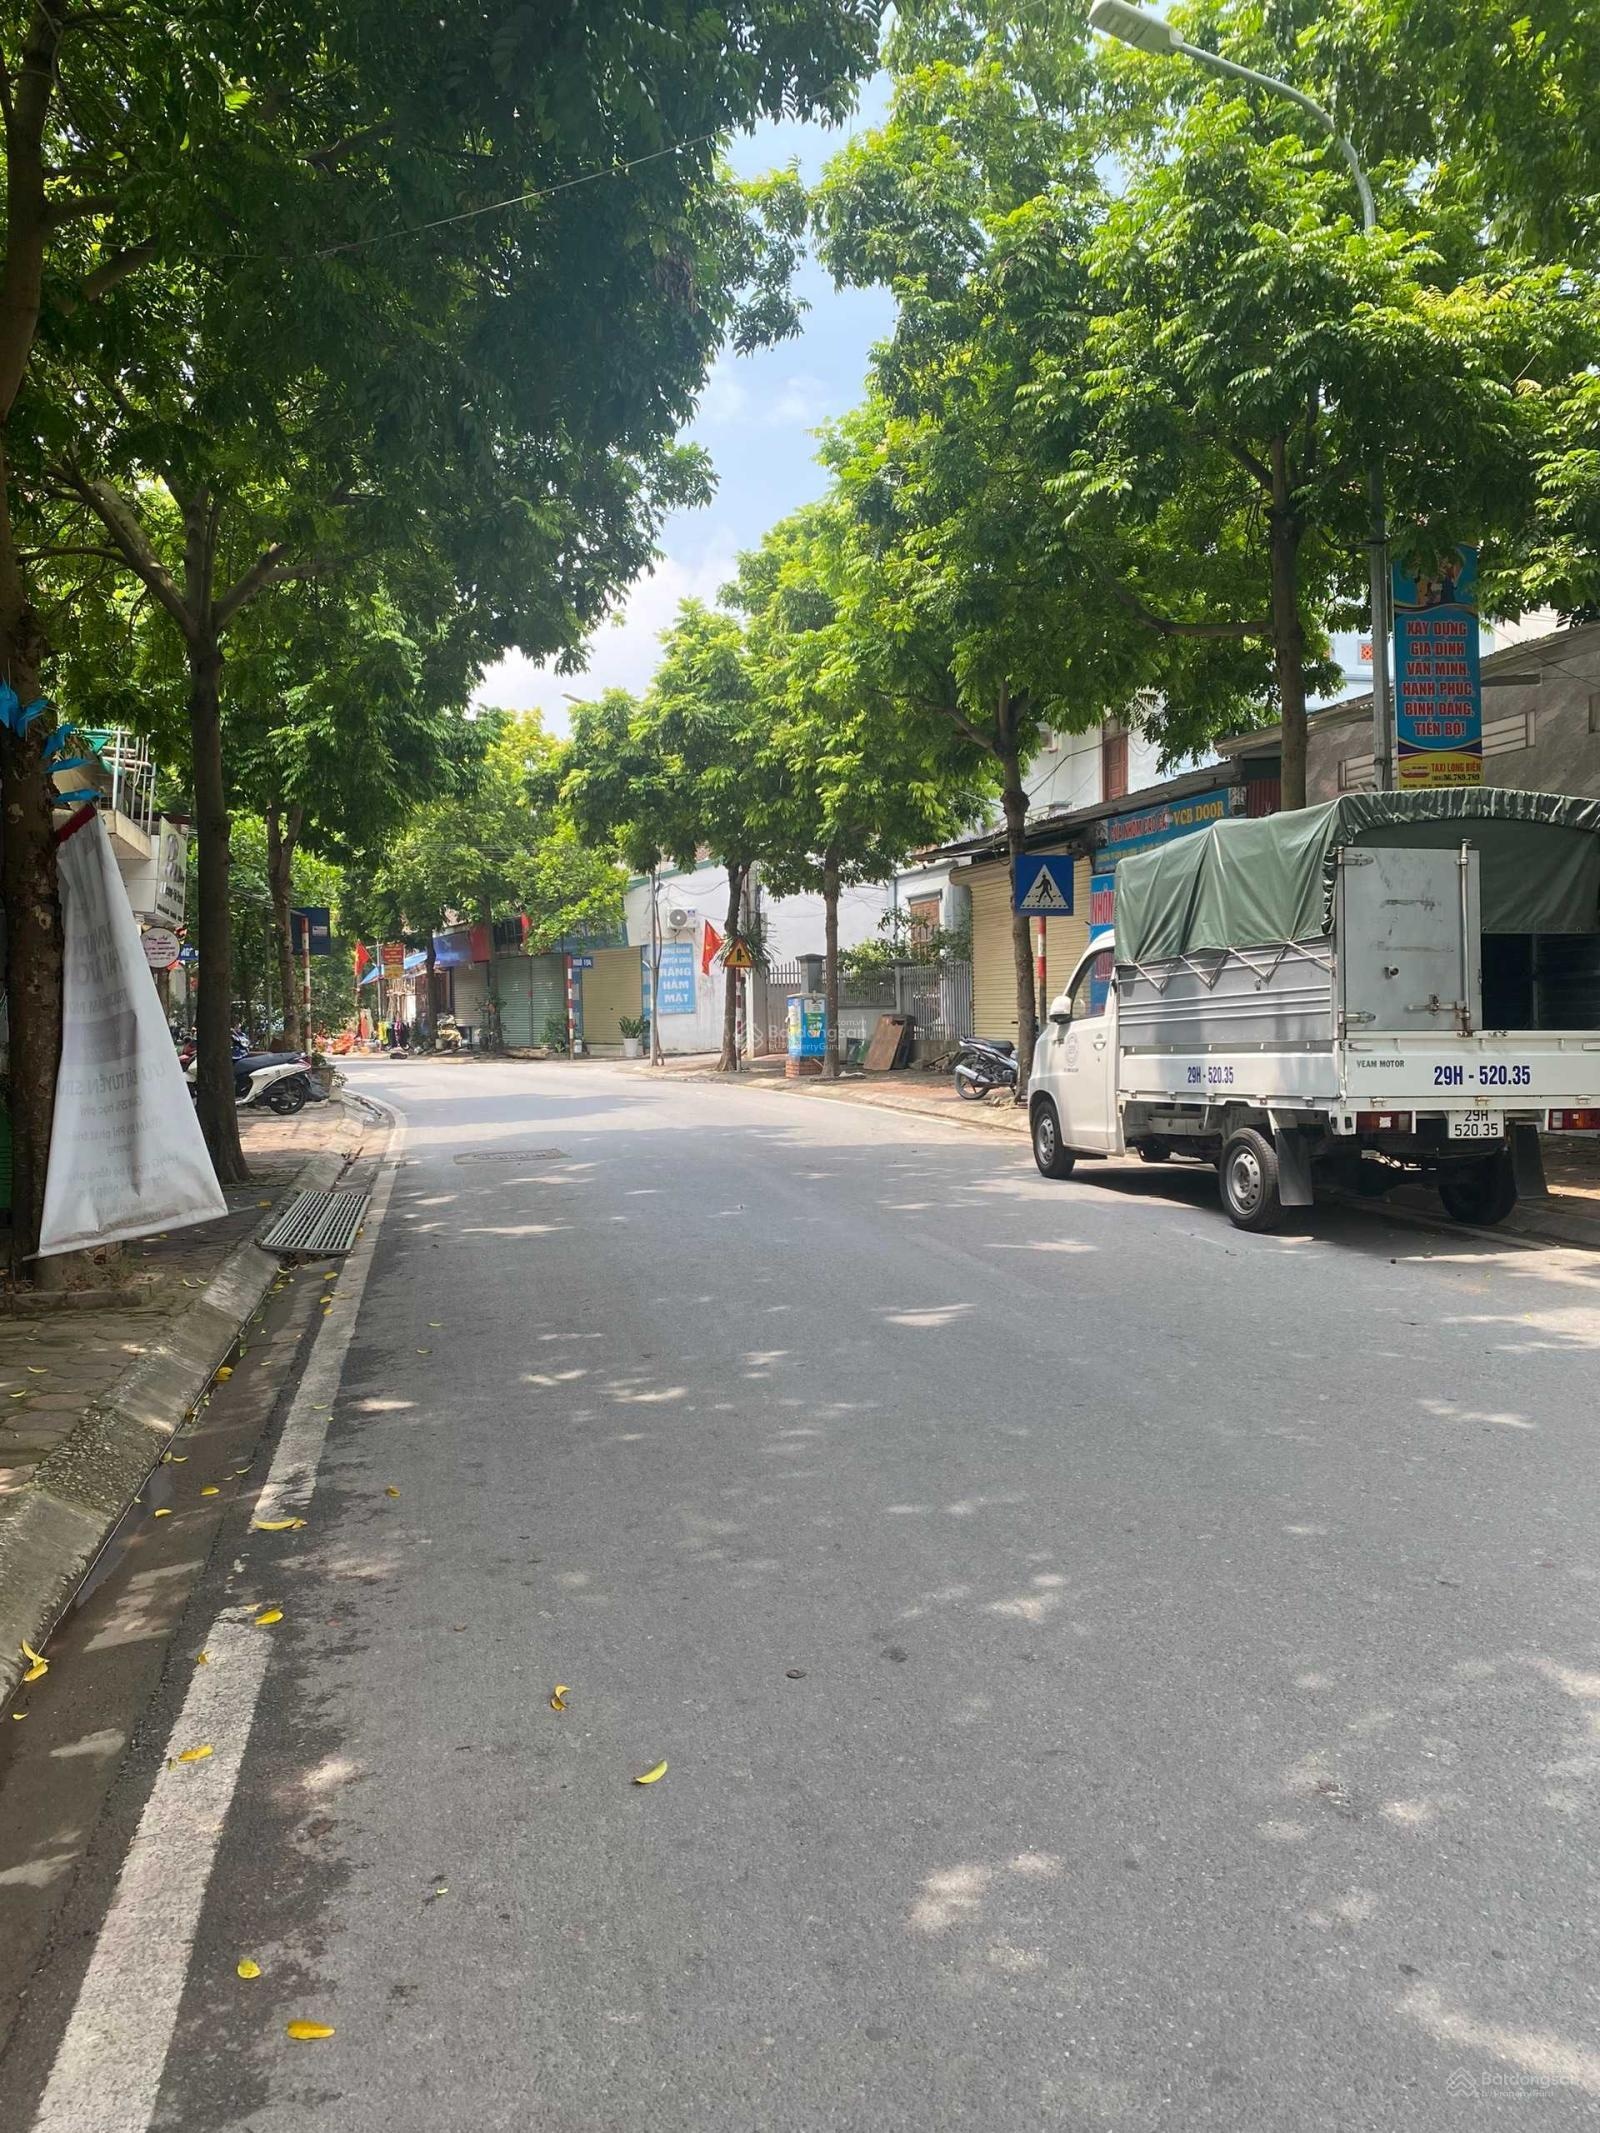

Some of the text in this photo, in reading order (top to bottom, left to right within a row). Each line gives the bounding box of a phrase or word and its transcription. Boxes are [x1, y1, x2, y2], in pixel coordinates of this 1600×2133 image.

[1410, 641, 1431, 656] GIA
[1431, 762, 1446, 772] TAXI
[1173, 810, 1193, 826] VCB
[1195, 801, 1225, 821] DOOR
[1379, 1060, 1405, 1068] MOTOR
[1187, 1066, 1201, 1083] 29H
[1208, 1066, 1234, 1083] 520.35
[1434, 1066, 1463, 1085] 29H
[1479, 1065, 1531, 1085] 520.35
[1465, 1110, 1488, 1121] 29H
[1454, 1123, 1498, 1136] 520.35
